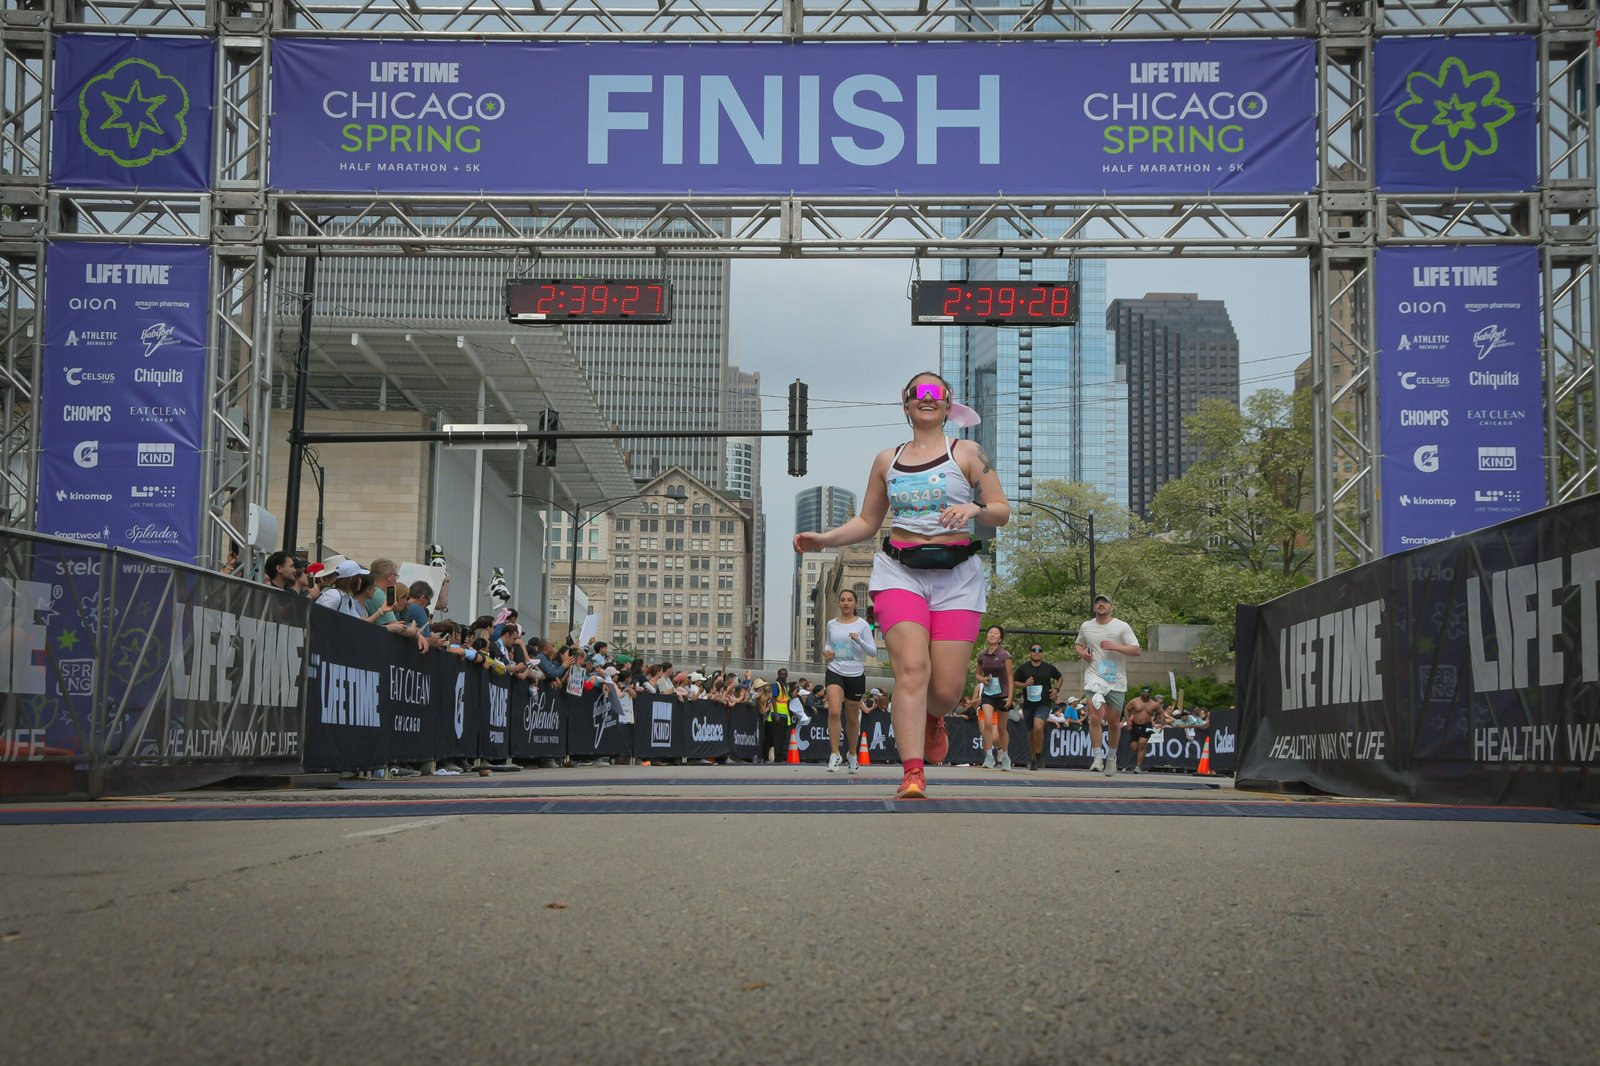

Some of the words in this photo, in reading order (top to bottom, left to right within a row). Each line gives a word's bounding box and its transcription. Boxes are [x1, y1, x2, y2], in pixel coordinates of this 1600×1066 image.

[371, 62, 409, 83] LIFE
[410, 62, 459, 83] TIME
[1131, 62, 1169, 83] LIFE
[1170, 62, 1220, 83] TIME
[322, 91, 505, 120] CHICAGO
[1083, 91, 1267, 121] CHICAGO
[587, 74, 1000, 166] FINISH
[341, 123, 482, 154] SPRING
[1103, 124, 1245, 154] SPRING
[340, 163, 371, 172] HALF
[377, 163, 448, 173] MARATHON
[465, 164, 481, 173] 5K
[1102, 163, 1134, 173] HALF
[1140, 163, 1211, 173] MARATHON
[1229, 163, 1245, 172] 5K
[86, 264, 122, 284] LIFE
[125, 264, 169, 285] TIME
[1413, 267, 1449, 286] LIFE
[1452, 266, 1498, 286] TIME
[135, 301, 158, 309] amazon
[159, 301, 190, 309] pharmacy
[81, 331, 118, 340] ATHLETIC
[140, 326, 175, 341] Babybel
[1413, 335, 1449, 343] ATHLETIC
[134, 368, 183, 387] Chiquita
[1469, 371, 1520, 390] Chiquita
[64, 405, 111, 422] CHOMPS
[130, 407, 148, 415] EAT
[152, 407, 186, 416] CLEAN
[1401, 409, 1449, 426] CHOMPS
[1468, 410, 1487, 418] EAT
[1489, 410, 1525, 418] CLEAN
[140, 453, 171, 464] KIND
[1481, 458, 1513, 467] KIND
[70, 492, 112, 502] kinomap
[1413, 496, 1456, 507] kinomap
[54, 531, 101, 540] Smartwool
[125, 524, 179, 543] Splendor
[1466, 557, 1564, 692] LIFE
[171, 602, 236, 703] LIFE
[240, 615, 304, 707] TIME
[1280, 618, 1317, 711] LIFE
[1319, 600, 1383, 705] TIME
[63, 677, 91, 691] NG
[390, 665, 404, 701] EAT
[405, 669, 431, 705] CLEAN
[321, 661, 346, 725] LIFE
[347, 666, 380, 727] TIME
[394, 715, 420, 732] CHICAGO
[653, 721, 670, 740] KIND
[692, 716, 724, 742] Cadence
[166, 728, 226, 757] HEALTHY
[231, 731, 257, 757] WAY
[261, 731, 276, 756] OF
[277, 732, 297, 755] LIFE
[810, 726, 844, 741] CELSS
[1214, 727, 1235, 753] Caden
[1474, 724, 1557, 761] HEALTHY
[0, 729, 46, 762] IFE
[1050, 729, 1109, 759] CHOMS
[1269, 734, 1317, 759] HEALTHY
[1319, 733, 1338, 759] WAY
[1340, 732, 1353, 759] OF
[1356, 731, 1384, 760] LIFE
